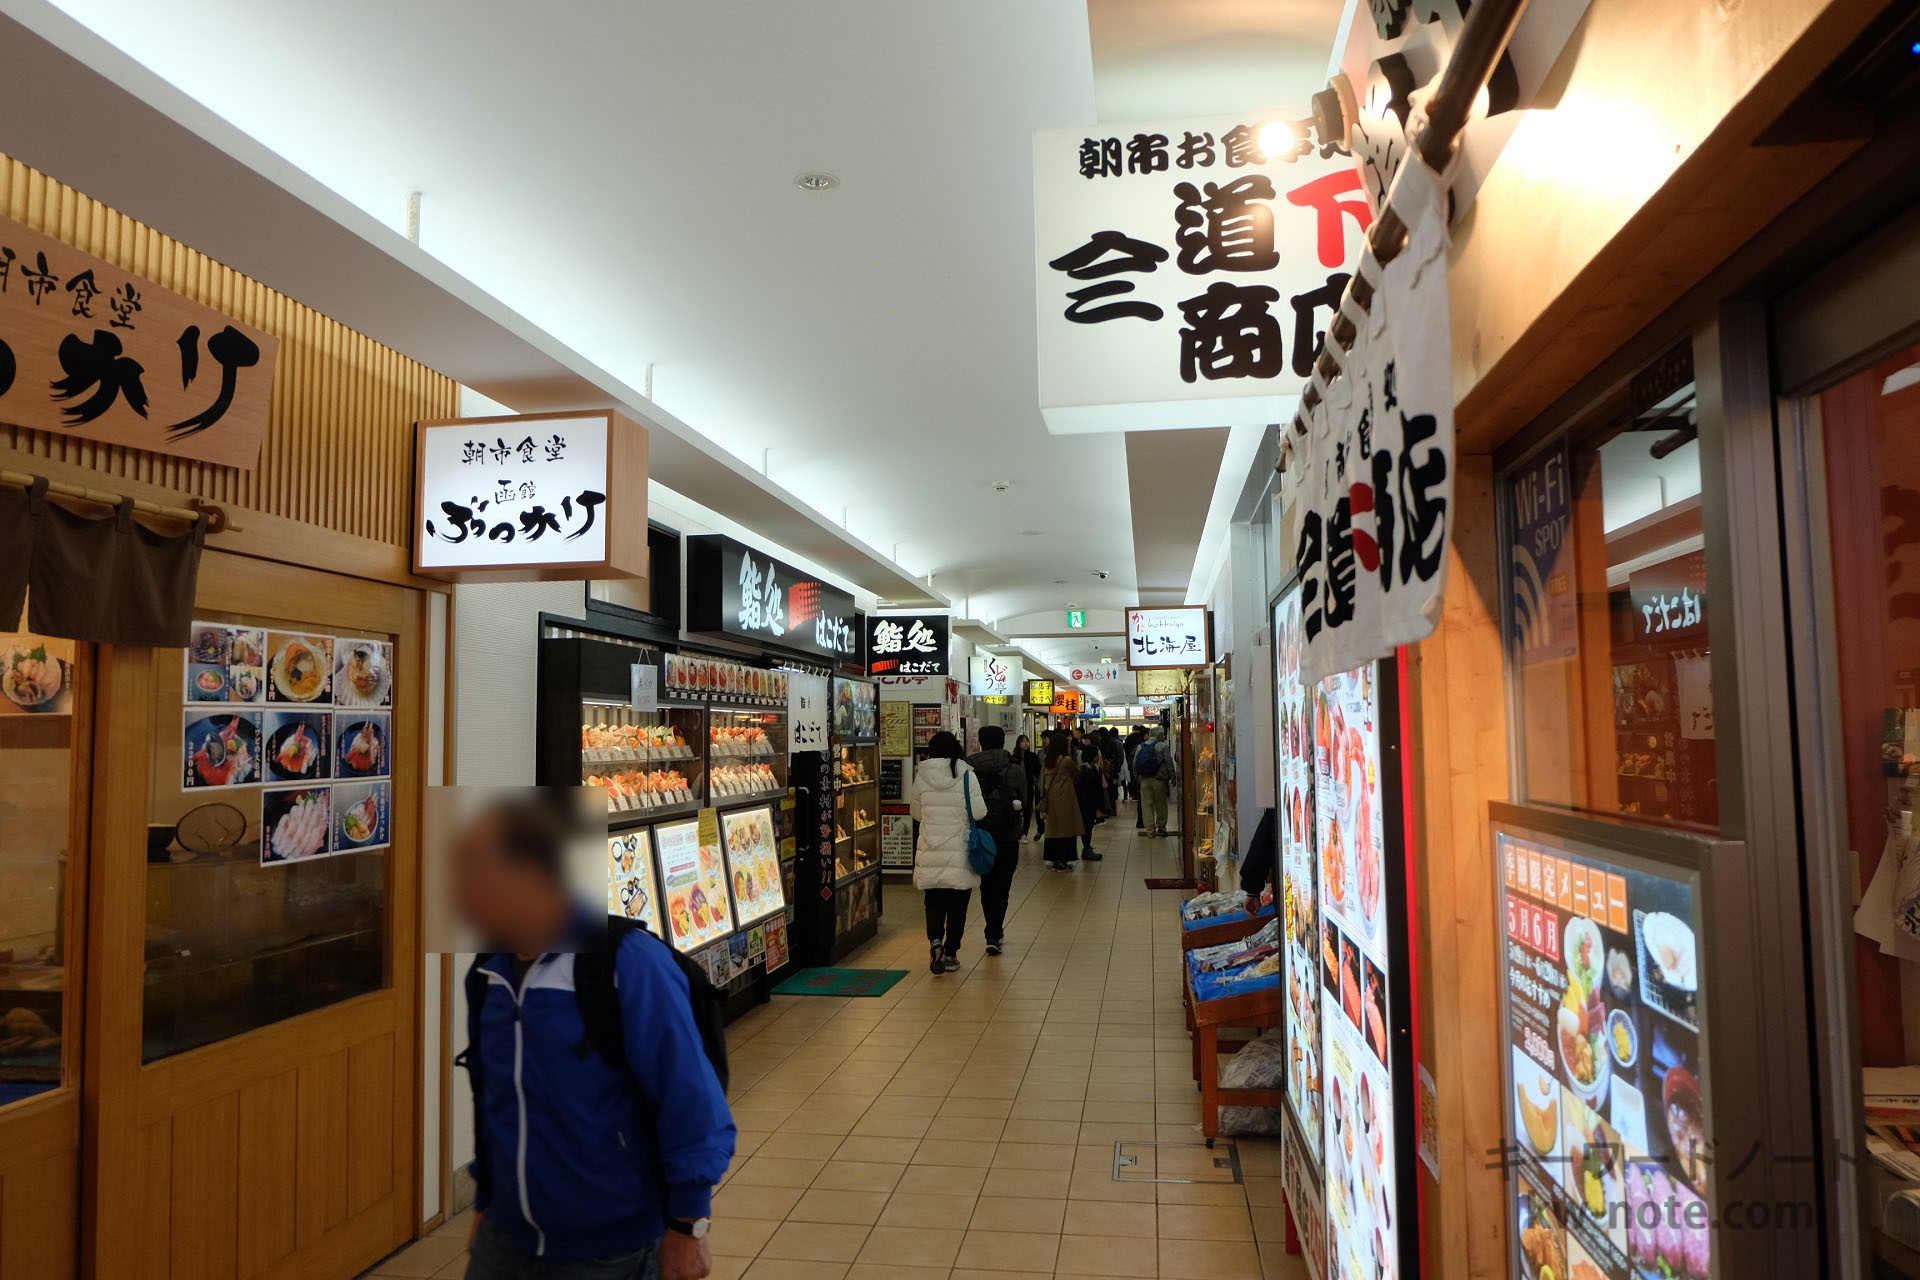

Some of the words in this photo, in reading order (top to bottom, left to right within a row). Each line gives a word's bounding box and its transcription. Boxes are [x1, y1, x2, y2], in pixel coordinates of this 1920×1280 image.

[0, 324, 261, 443] かけ
[461, 436, 567, 466] 朝市食堂
[494, 479, 538, 505] 函館
[1514, 451, 1565, 532] Wi-Fi
[425, 489, 607, 545] ぶっかけ
[1533, 517, 1568, 559] SPOT
[738, 550, 785, 637] 鮨処
[815, 609, 850, 653] はこだて
[871, 619, 938, 654] 鮨処
[1131, 611, 1144, 633] かに
[1132, 634, 1202, 656] 北海屋
[899, 660, 941, 675] はこだて
[1506, 851, 1625, 911] 季節限定メニュー
